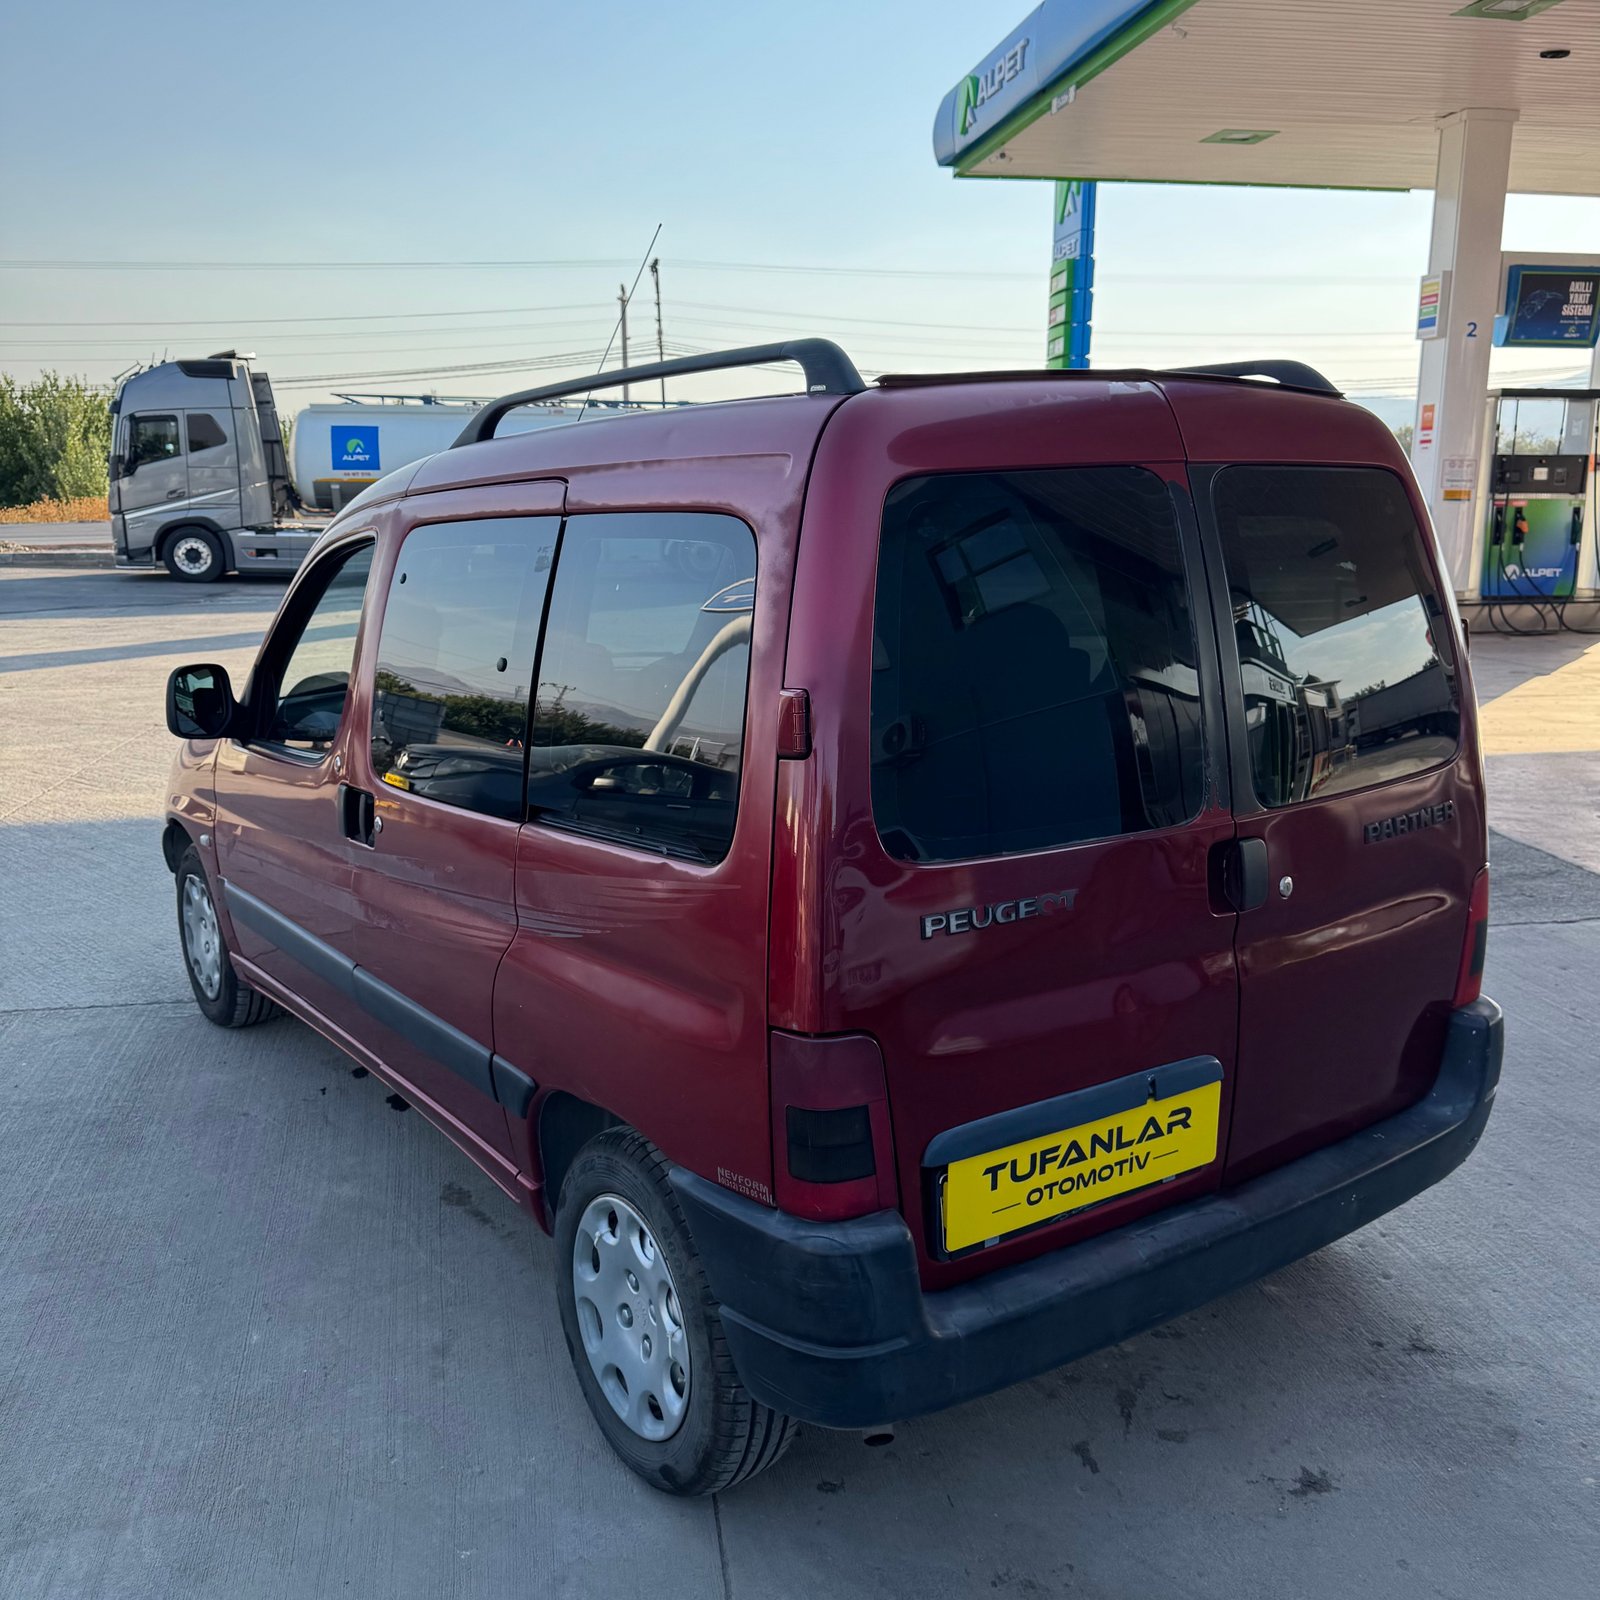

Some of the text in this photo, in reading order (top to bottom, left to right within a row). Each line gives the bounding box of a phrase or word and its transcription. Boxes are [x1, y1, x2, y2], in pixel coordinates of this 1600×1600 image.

[977, 38, 1030, 107] ALPET
[1569, 281, 1593, 292] AKILLI
[1569, 293, 1591, 304] YAKIT
[1466, 322, 1478, 337] 2
[1521, 568, 1563, 578] ALPET
[1364, 800, 1455, 844] PARTNER
[920, 888, 1079, 940] PEUGEOT
[982, 1106, 1192, 1192] TUFANLAR
[717, 1166, 769, 1202] NEVFORM
[1026, 1151, 1151, 1207] OTOMOTİV
